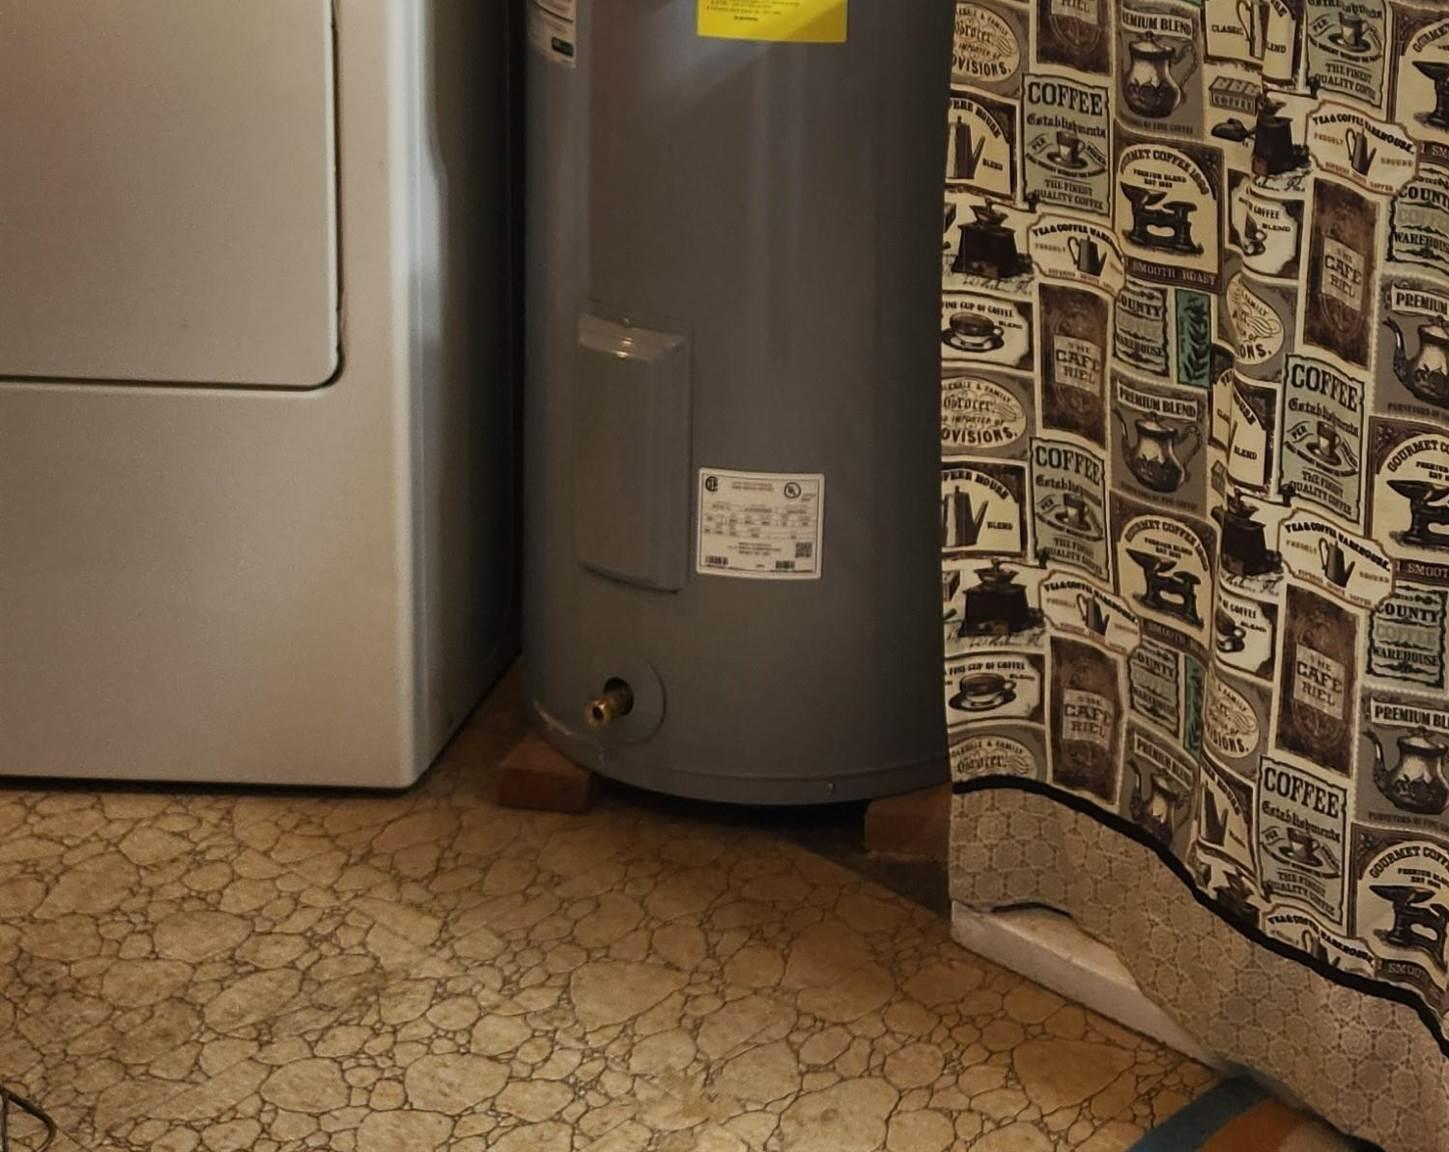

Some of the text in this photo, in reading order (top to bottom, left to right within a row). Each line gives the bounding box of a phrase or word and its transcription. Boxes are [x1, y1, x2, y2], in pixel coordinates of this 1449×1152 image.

[1160, 17, 1193, 37] BLEND
[1028, 81, 1103, 116] COFFEE
[1395, 291, 1449, 315] PREMIUM
[1291, 364, 1359, 412] COFFEE
[1162, 400, 1196, 418] BLEND
[1387, 440, 1439, 472] GOURMET
[1297, 662, 1343, 706] CAFE RIEL
[1374, 705, 1431, 726] PREMIUM
[1263, 767, 1340, 819] COFFEE
